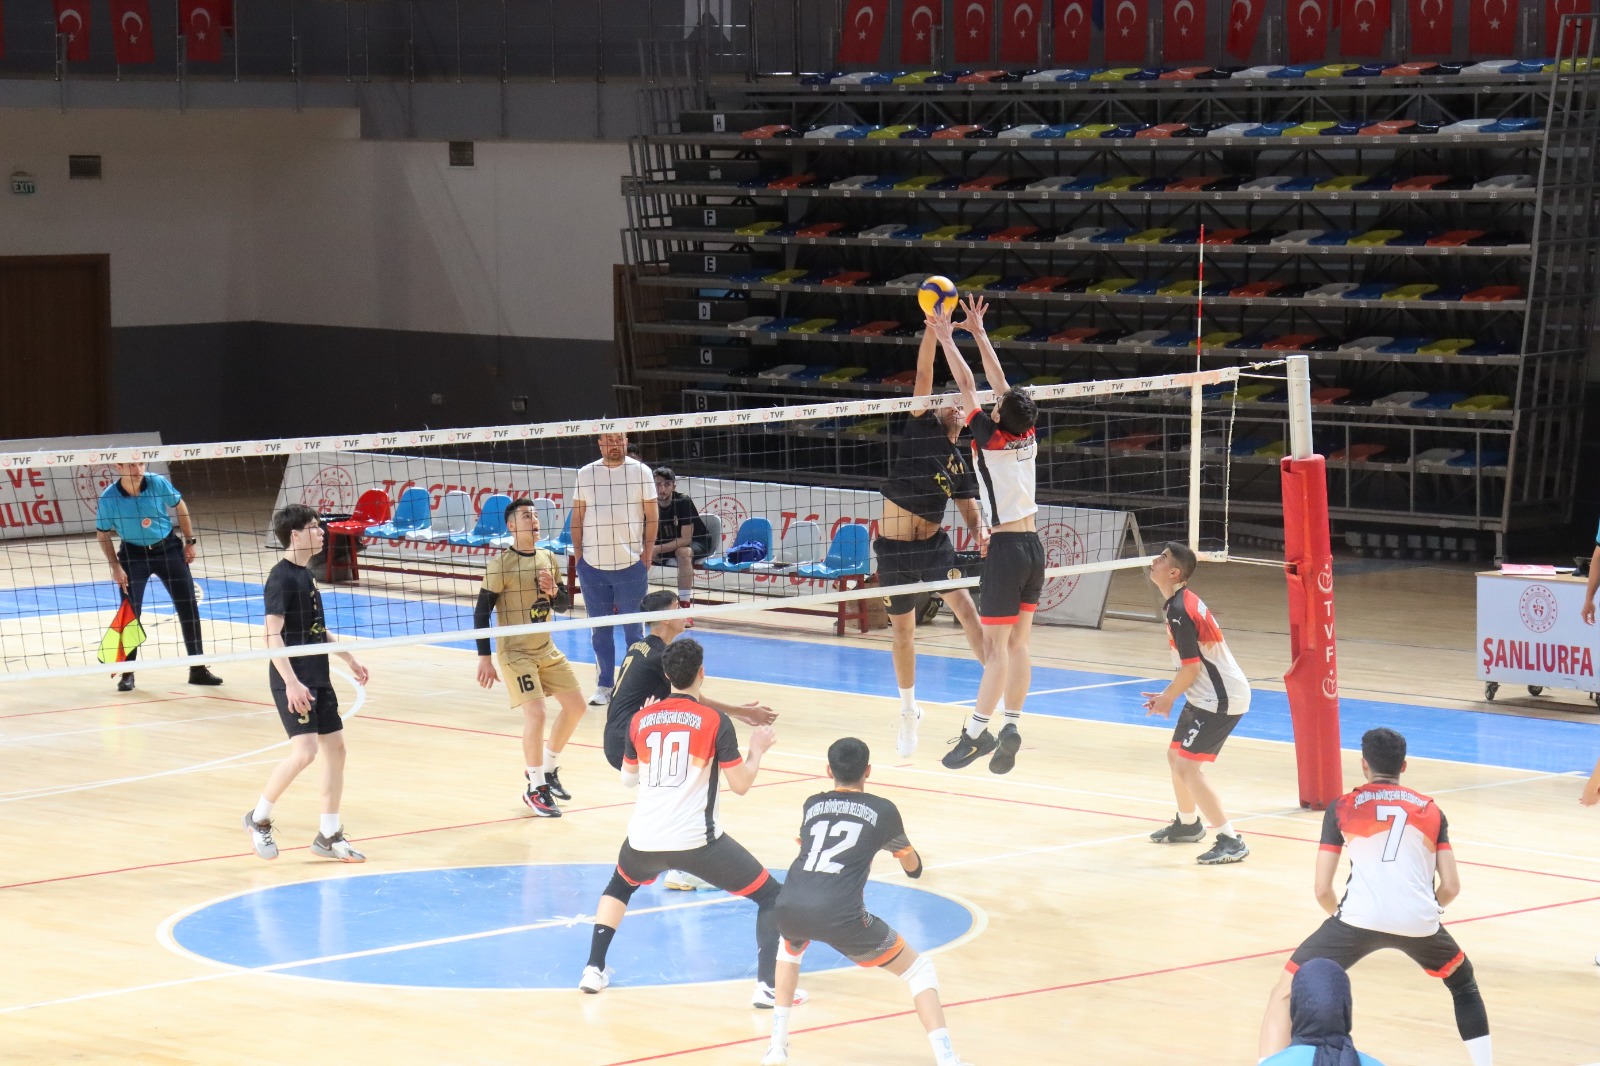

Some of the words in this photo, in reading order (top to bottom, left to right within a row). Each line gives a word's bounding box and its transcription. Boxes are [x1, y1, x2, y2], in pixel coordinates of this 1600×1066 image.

[13, 182, 35, 193] EXIT
[13, 457, 31, 465] TVF
[57, 455, 75, 463] TVF
[100, 453, 117, 461] TVF
[142, 451, 159, 459] TVF
[184, 449, 201, 457] TVF
[225, 446, 242, 454] TVF
[265, 444, 282, 452] TVF
[304, 442, 320, 450] TVF
[343, 440, 359, 448] TVF
[381, 437, 397, 445] TVF
[419, 435, 435, 443] TVF
[457, 432, 472, 440] TVF
[493, 430, 508, 438] TVF
[529, 428, 544, 436] TVF
[565, 425, 580, 433] TVF
[600, 423, 615, 431] TVF
[635, 421, 649, 429] TVF
[669, 419, 683, 427] TVF
[704, 416, 718, 424] TVF
[737, 414, 751, 422] TVF
[770, 411, 784, 419] TVF
[803, 409, 817, 417] TVF
[835, 406, 848, 414] TVF
[868, 404, 881, 412] TVF
[899, 401, 912, 409] TVF
[930, 398, 943, 406] TVF
[1053, 388, 1066, 396] TVF
[1083, 386, 1096, 394] TVF
[1111, 383, 1124, 391] TVF
[1141, 381, 1154, 389] TVF
[1483, 637, 1594, 677] ŞANLIURFA
[517, 674, 535, 694] 16
[645, 731, 690, 787] 10
[1182, 728, 1200, 748] 3
[803, 820, 864, 875] 12
[1376, 805, 1408, 862] 7
